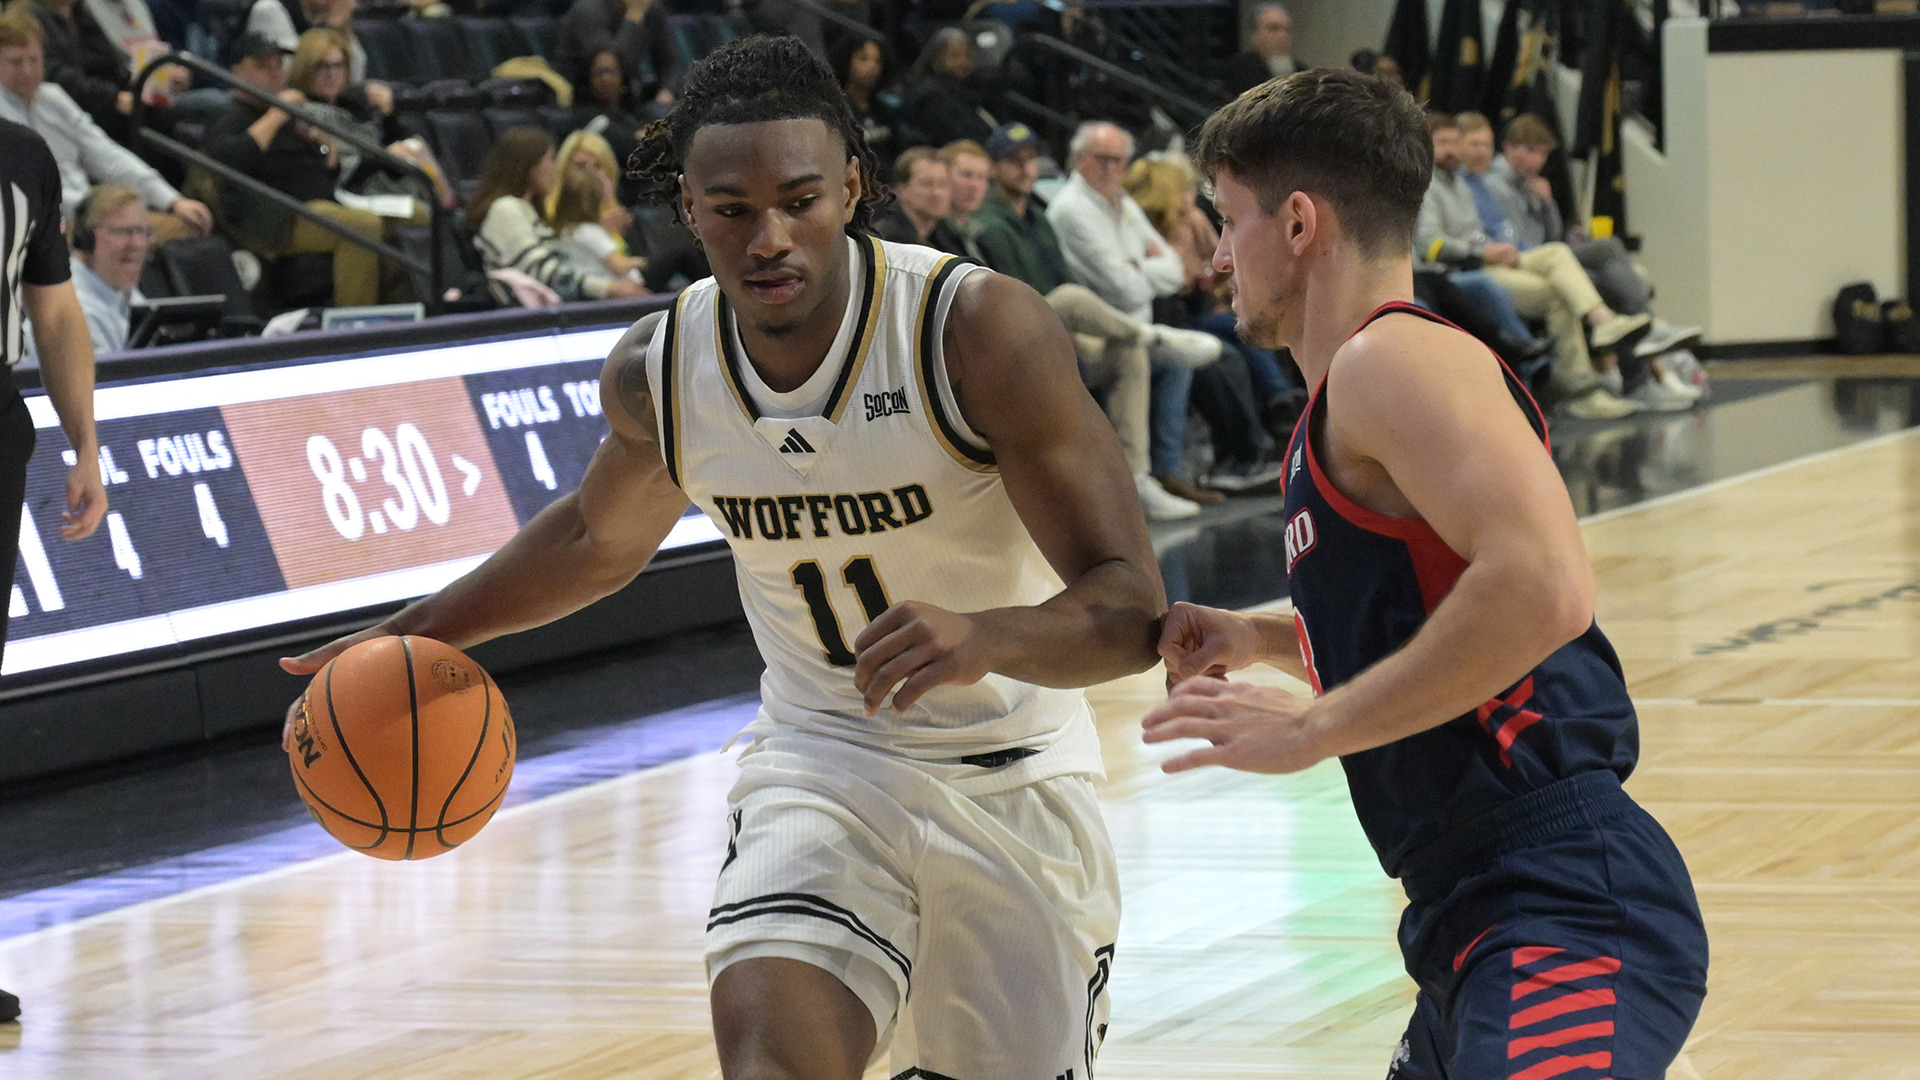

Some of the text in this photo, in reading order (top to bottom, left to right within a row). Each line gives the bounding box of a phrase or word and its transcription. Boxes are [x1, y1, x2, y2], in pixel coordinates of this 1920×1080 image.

[481, 386, 561, 430] FOULS
[137, 430, 233, 479] FOULS
[306, 422, 451, 541] 8:30
[524, 430, 558, 490] 4
[193, 482, 229, 548] 4
[712, 482, 934, 541] WOFFORD
[1284, 507, 1316, 576] RD
[106, 511, 143, 580] 4
[788, 554, 894, 669] 11
